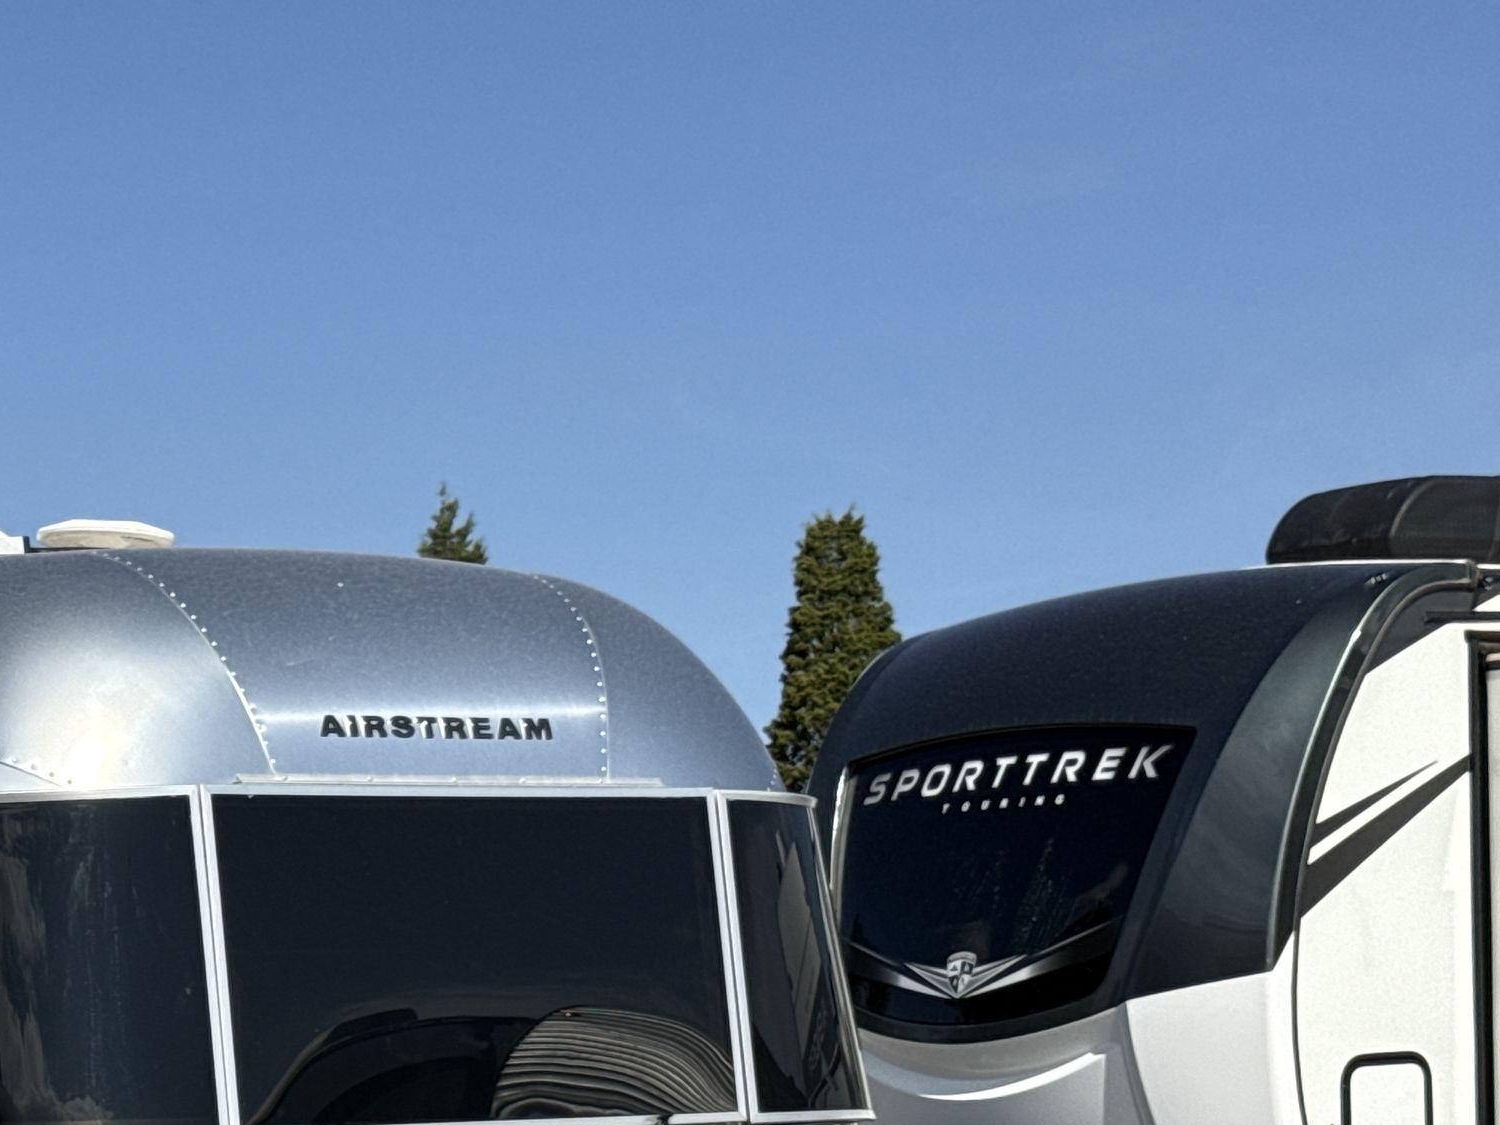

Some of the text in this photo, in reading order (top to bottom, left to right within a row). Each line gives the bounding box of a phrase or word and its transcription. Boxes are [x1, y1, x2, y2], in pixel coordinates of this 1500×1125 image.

[320, 714, 553, 740] AIRSTREAM
[863, 745, 1174, 806] SPORTTREK
[941, 793, 1065, 815] TOURING
